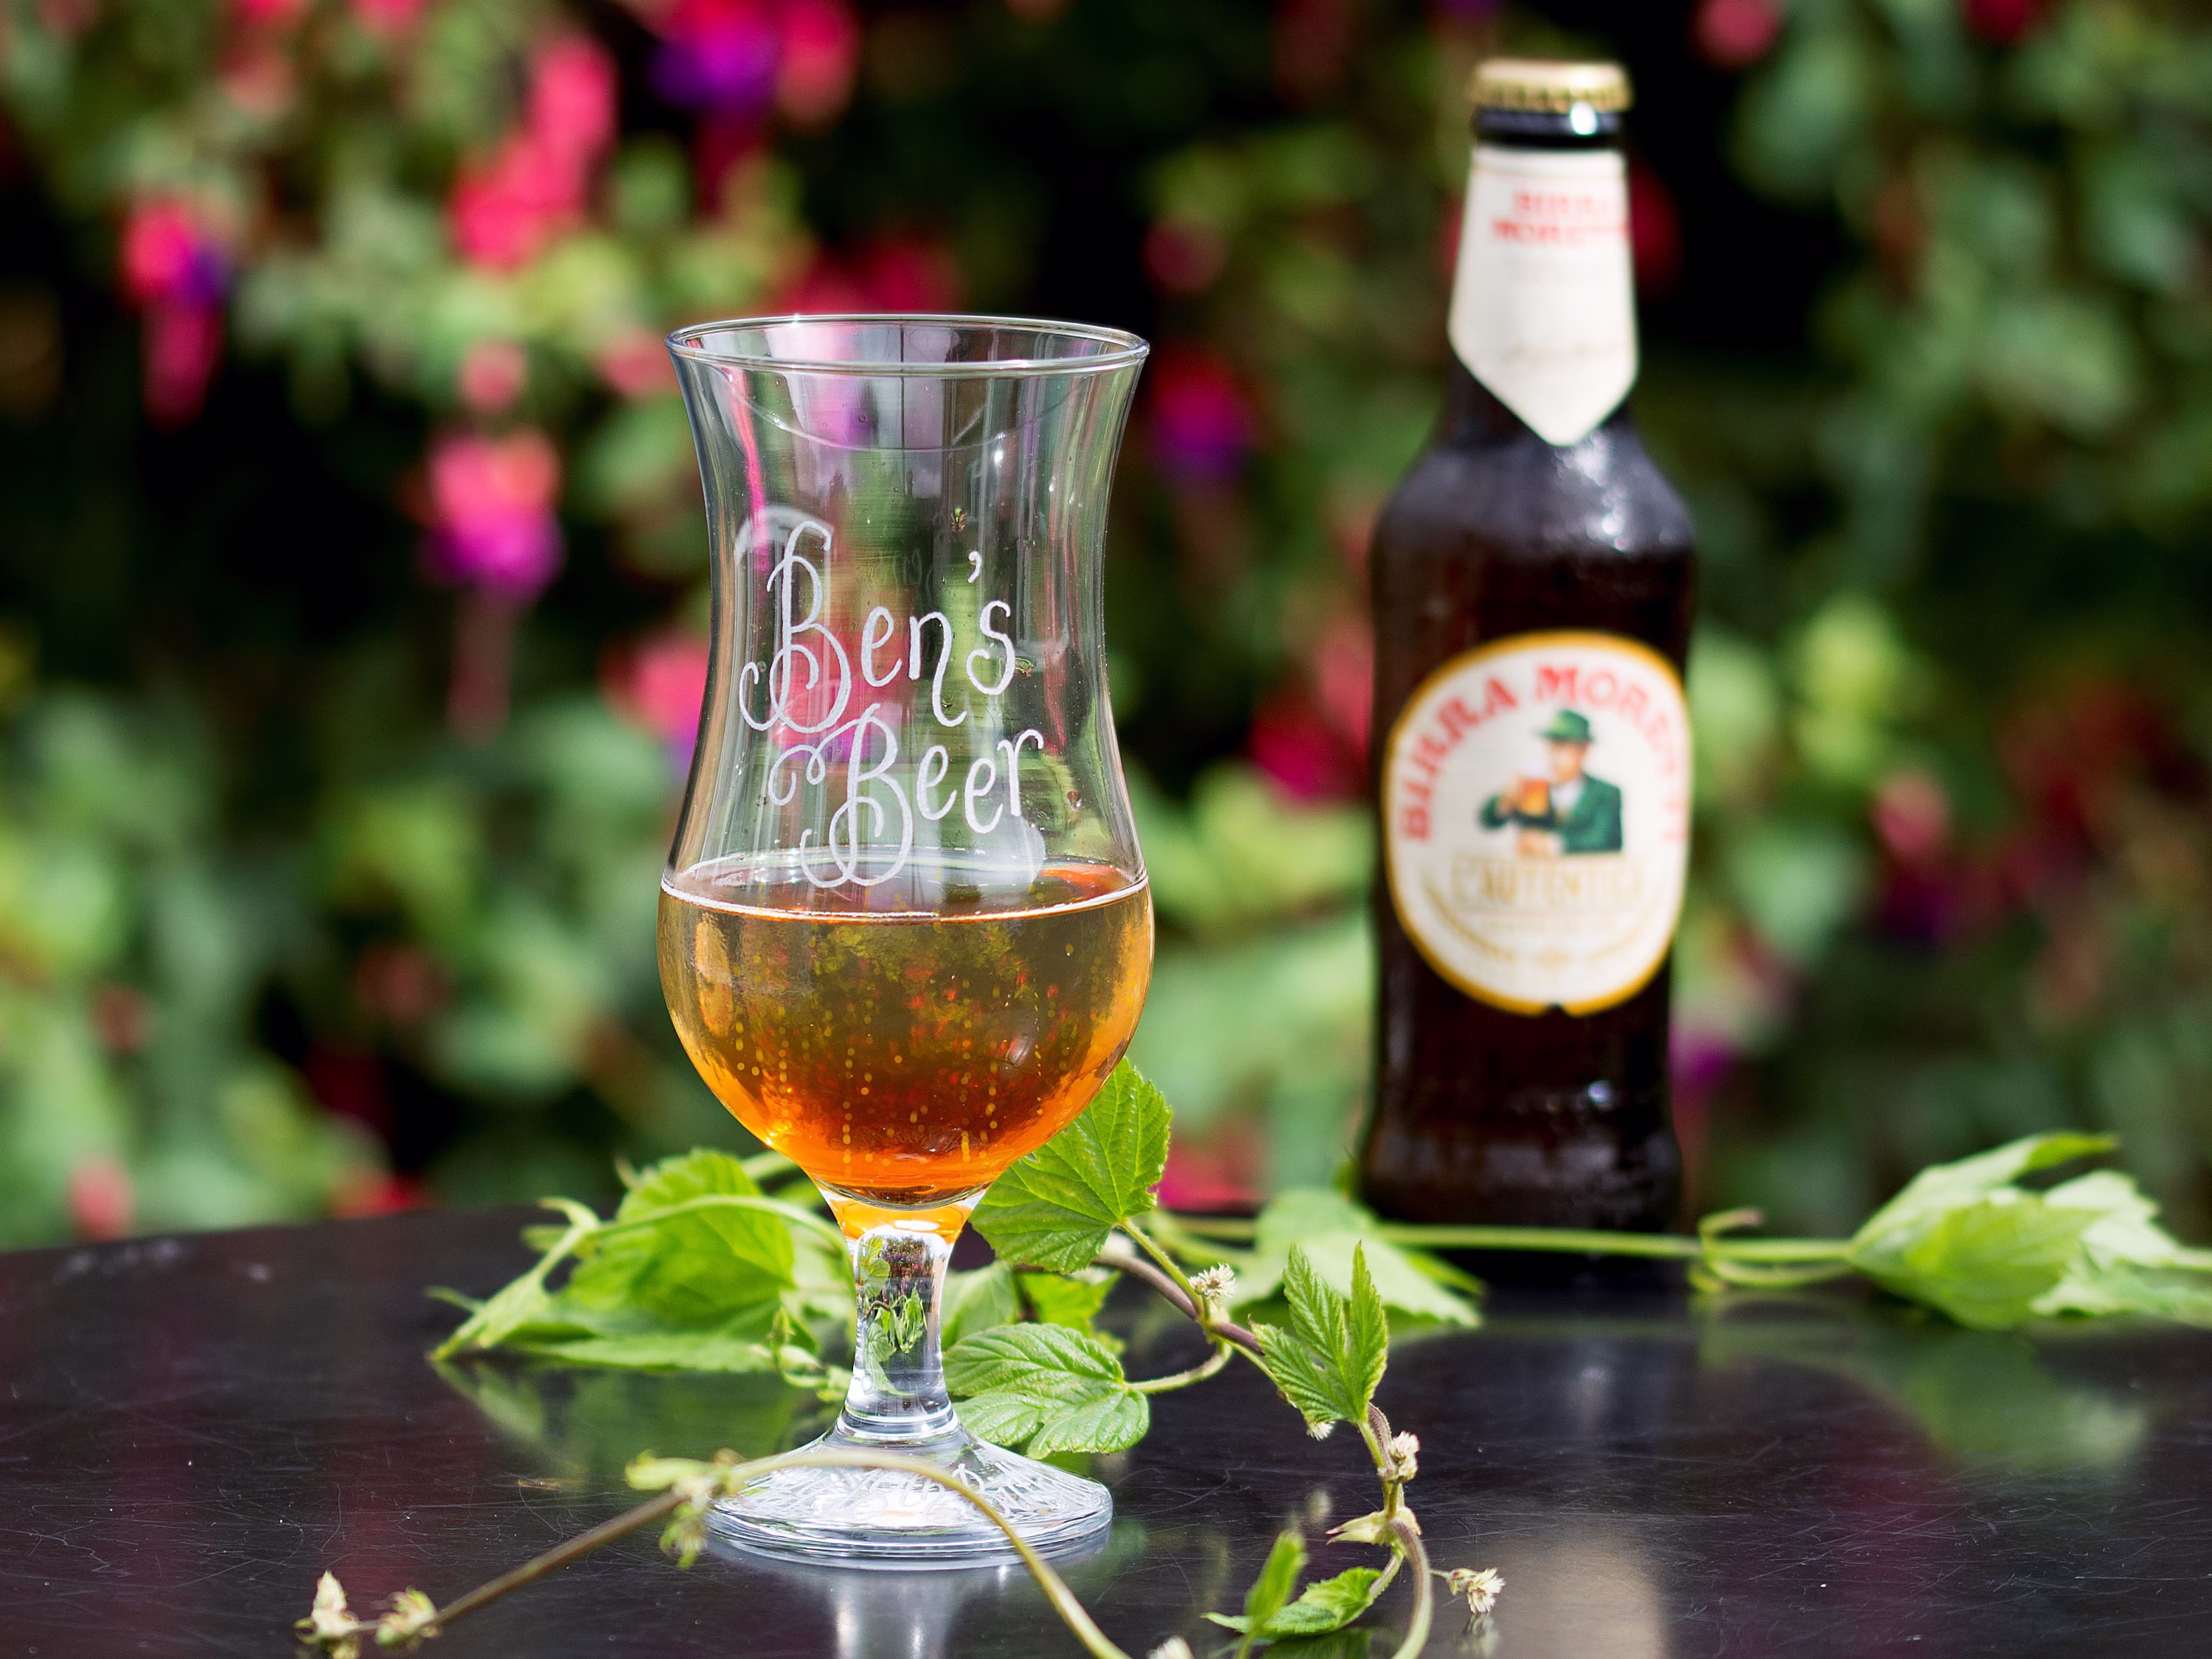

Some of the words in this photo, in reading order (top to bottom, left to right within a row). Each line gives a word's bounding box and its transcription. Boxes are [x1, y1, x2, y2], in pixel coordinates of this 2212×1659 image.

[739, 520, 1016, 733] Ben's
[768, 703, 1044, 888] Beer
[1401, 675, 1519, 843] BIRRA
